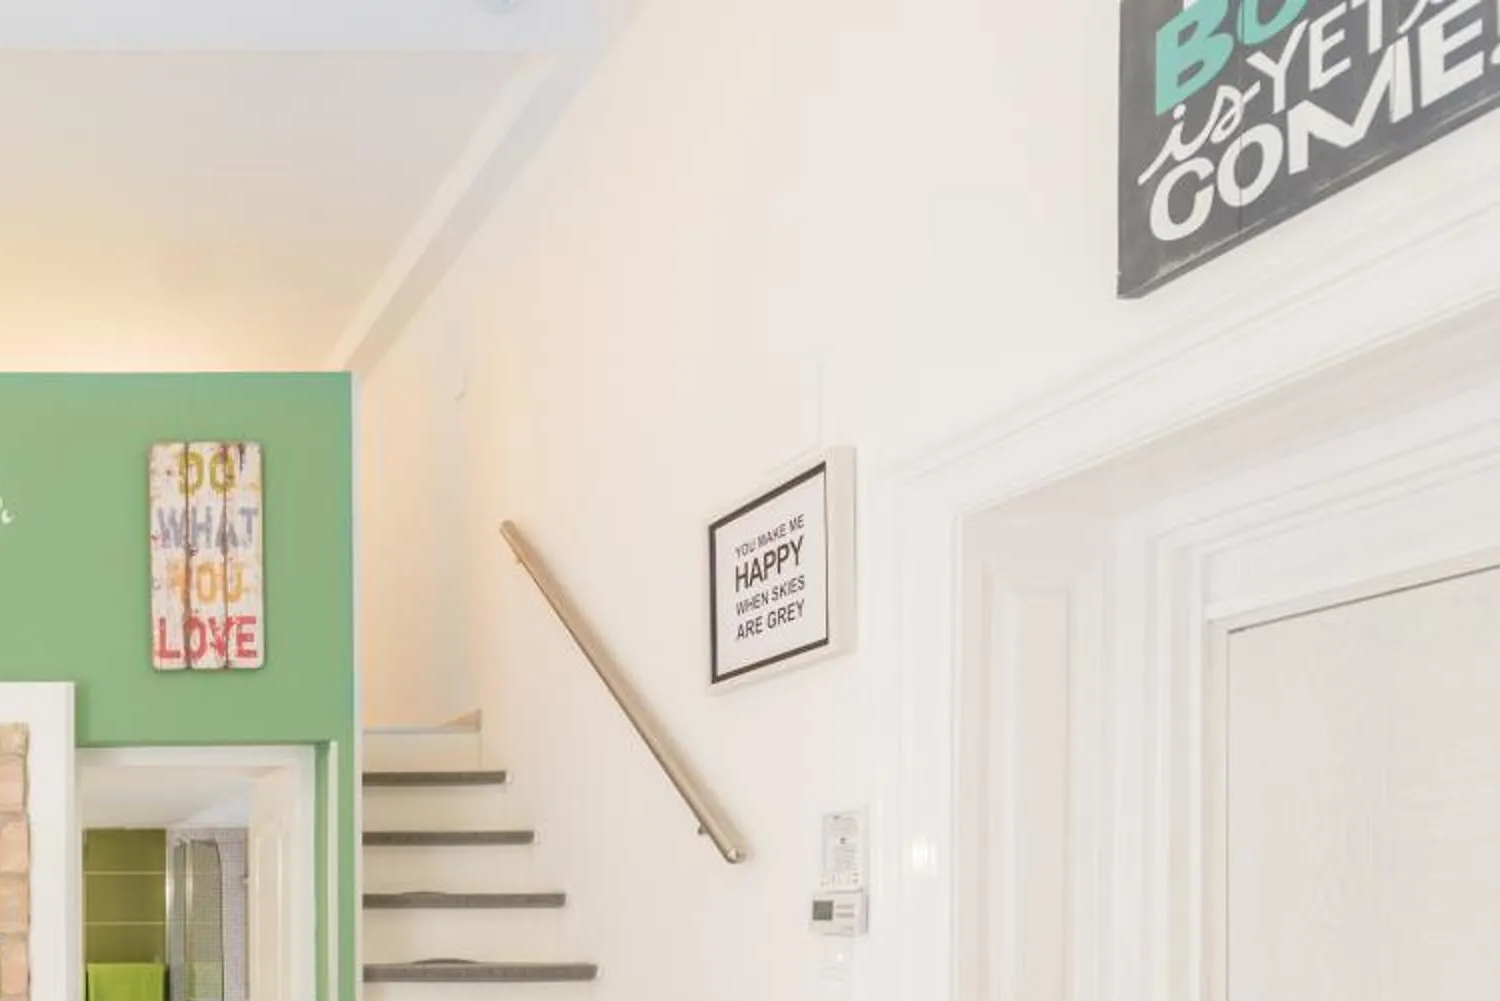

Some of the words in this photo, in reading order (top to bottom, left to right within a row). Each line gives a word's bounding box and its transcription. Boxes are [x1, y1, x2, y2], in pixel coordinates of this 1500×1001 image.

[1138, 80, 1261, 186] is
[1246, 0, 1383, 114] YET
[177, 450, 237, 496] DO
[157, 505, 258, 550] WHAT
[735, 538, 756, 558] YOU
[757, 523, 786, 547] MAKE
[789, 513, 804, 532] ME
[167, 560, 243, 604] YOU
[735, 534, 804, 593] HAPPY
[736, 592, 769, 616] WHEN
[771, 574, 805, 601] SKIES
[156, 615, 257, 660] LOVE
[736, 615, 763, 640] ARE
[767, 597, 805, 629] GREY
